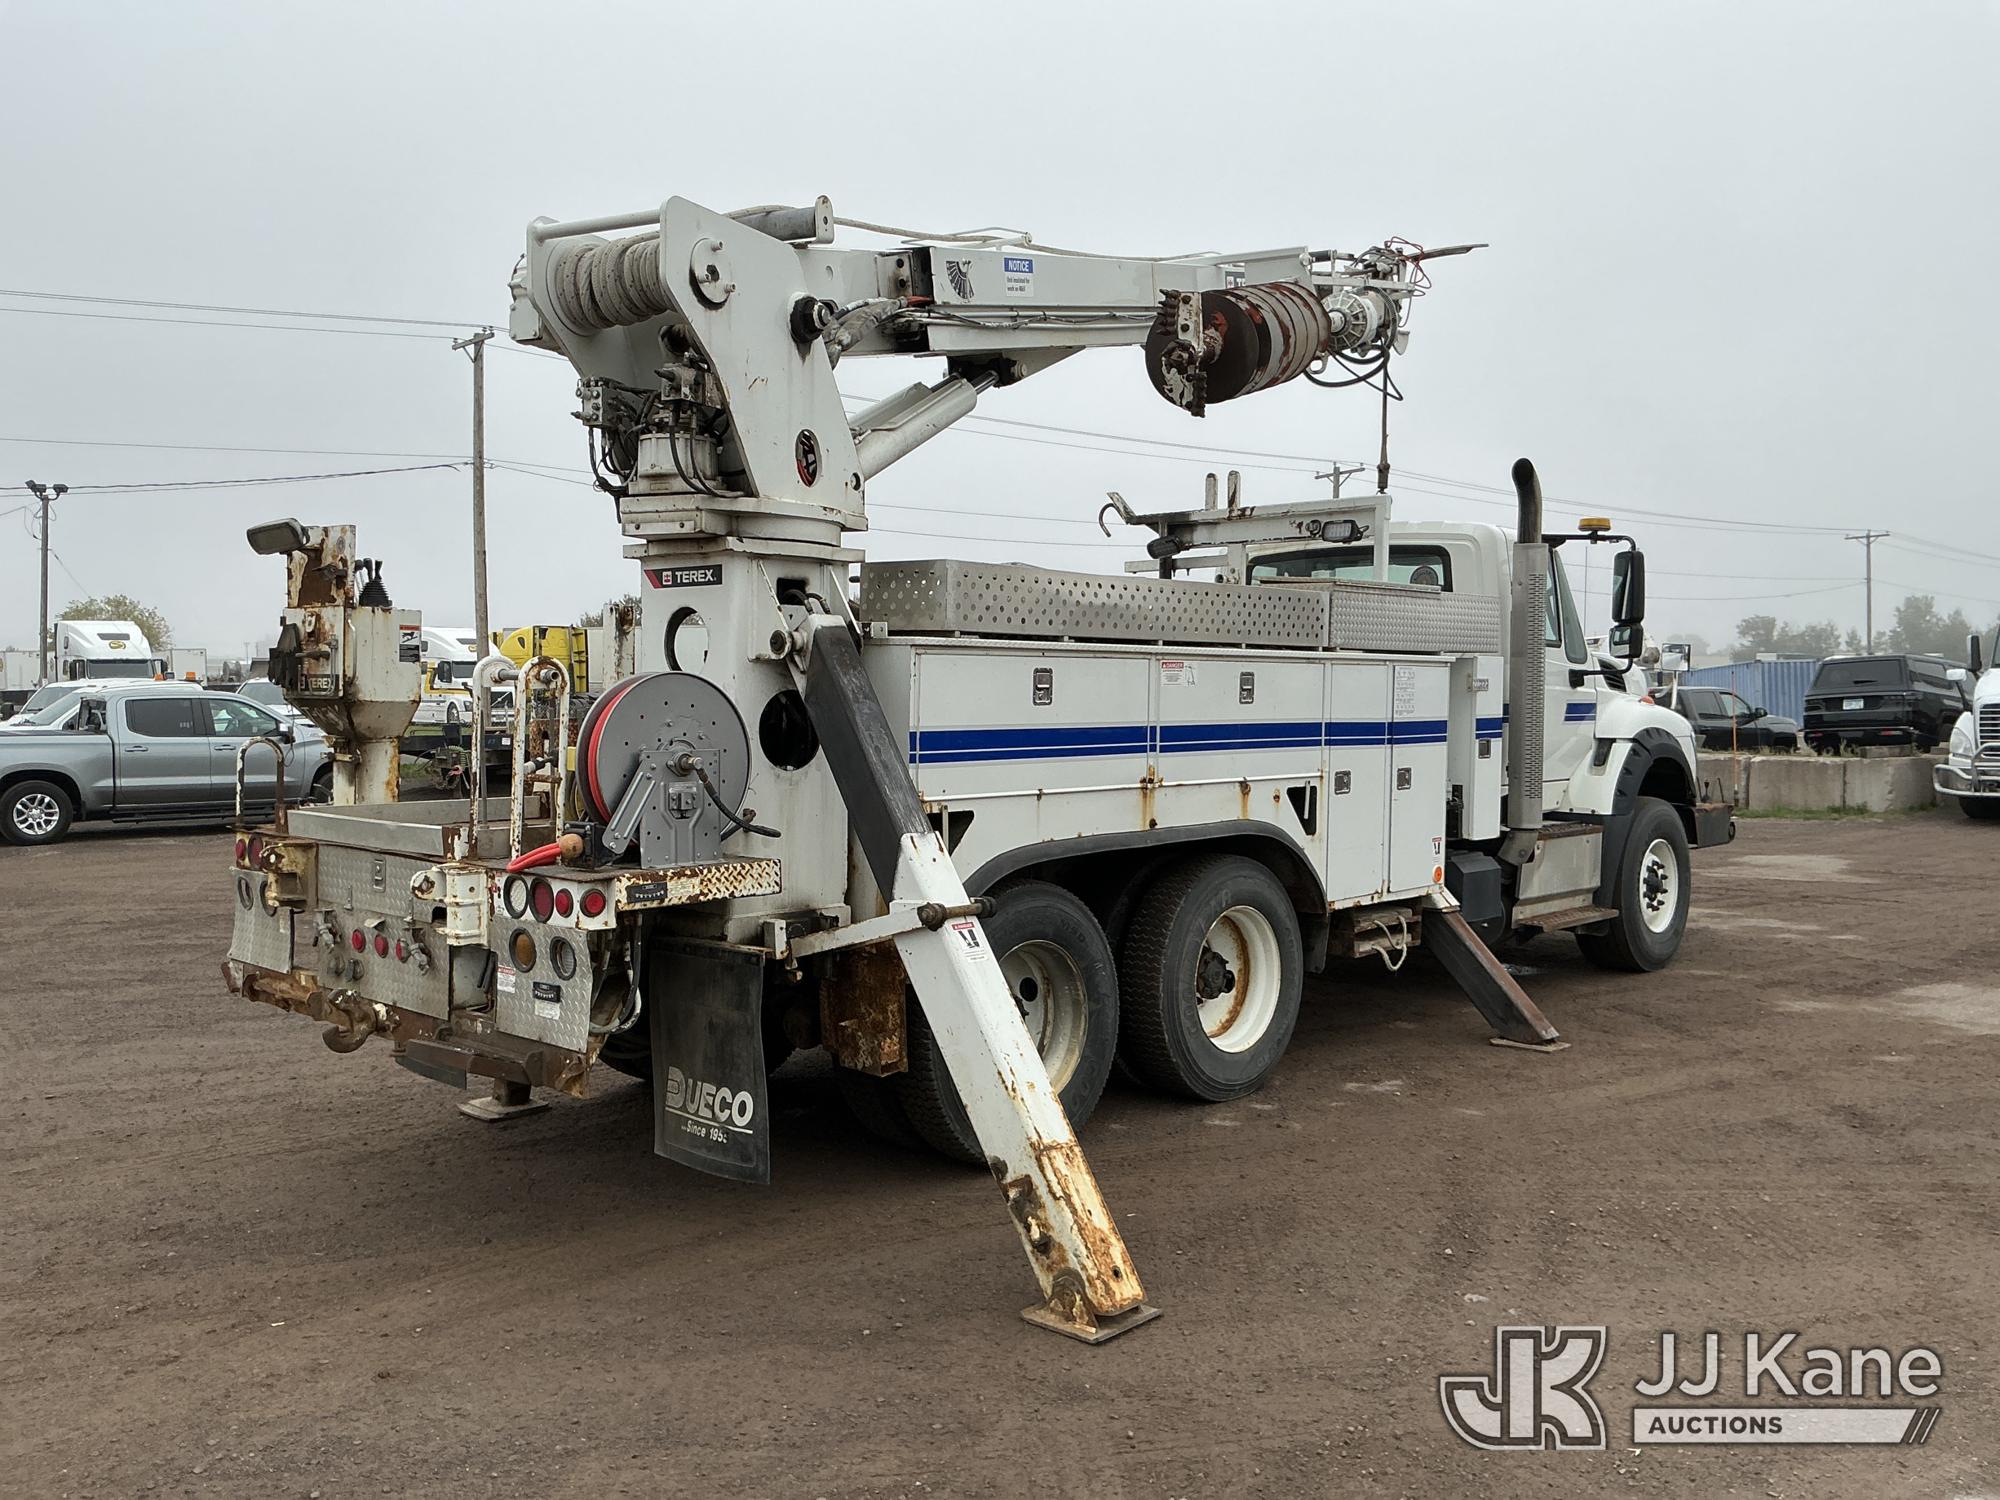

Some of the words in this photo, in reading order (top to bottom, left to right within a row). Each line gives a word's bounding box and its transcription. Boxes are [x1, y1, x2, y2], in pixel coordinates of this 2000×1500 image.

[1008, 260, 1030, 272] NOTICE
[675, 569, 714, 584] TEREX
[665, 1066, 754, 1127] DUECO
